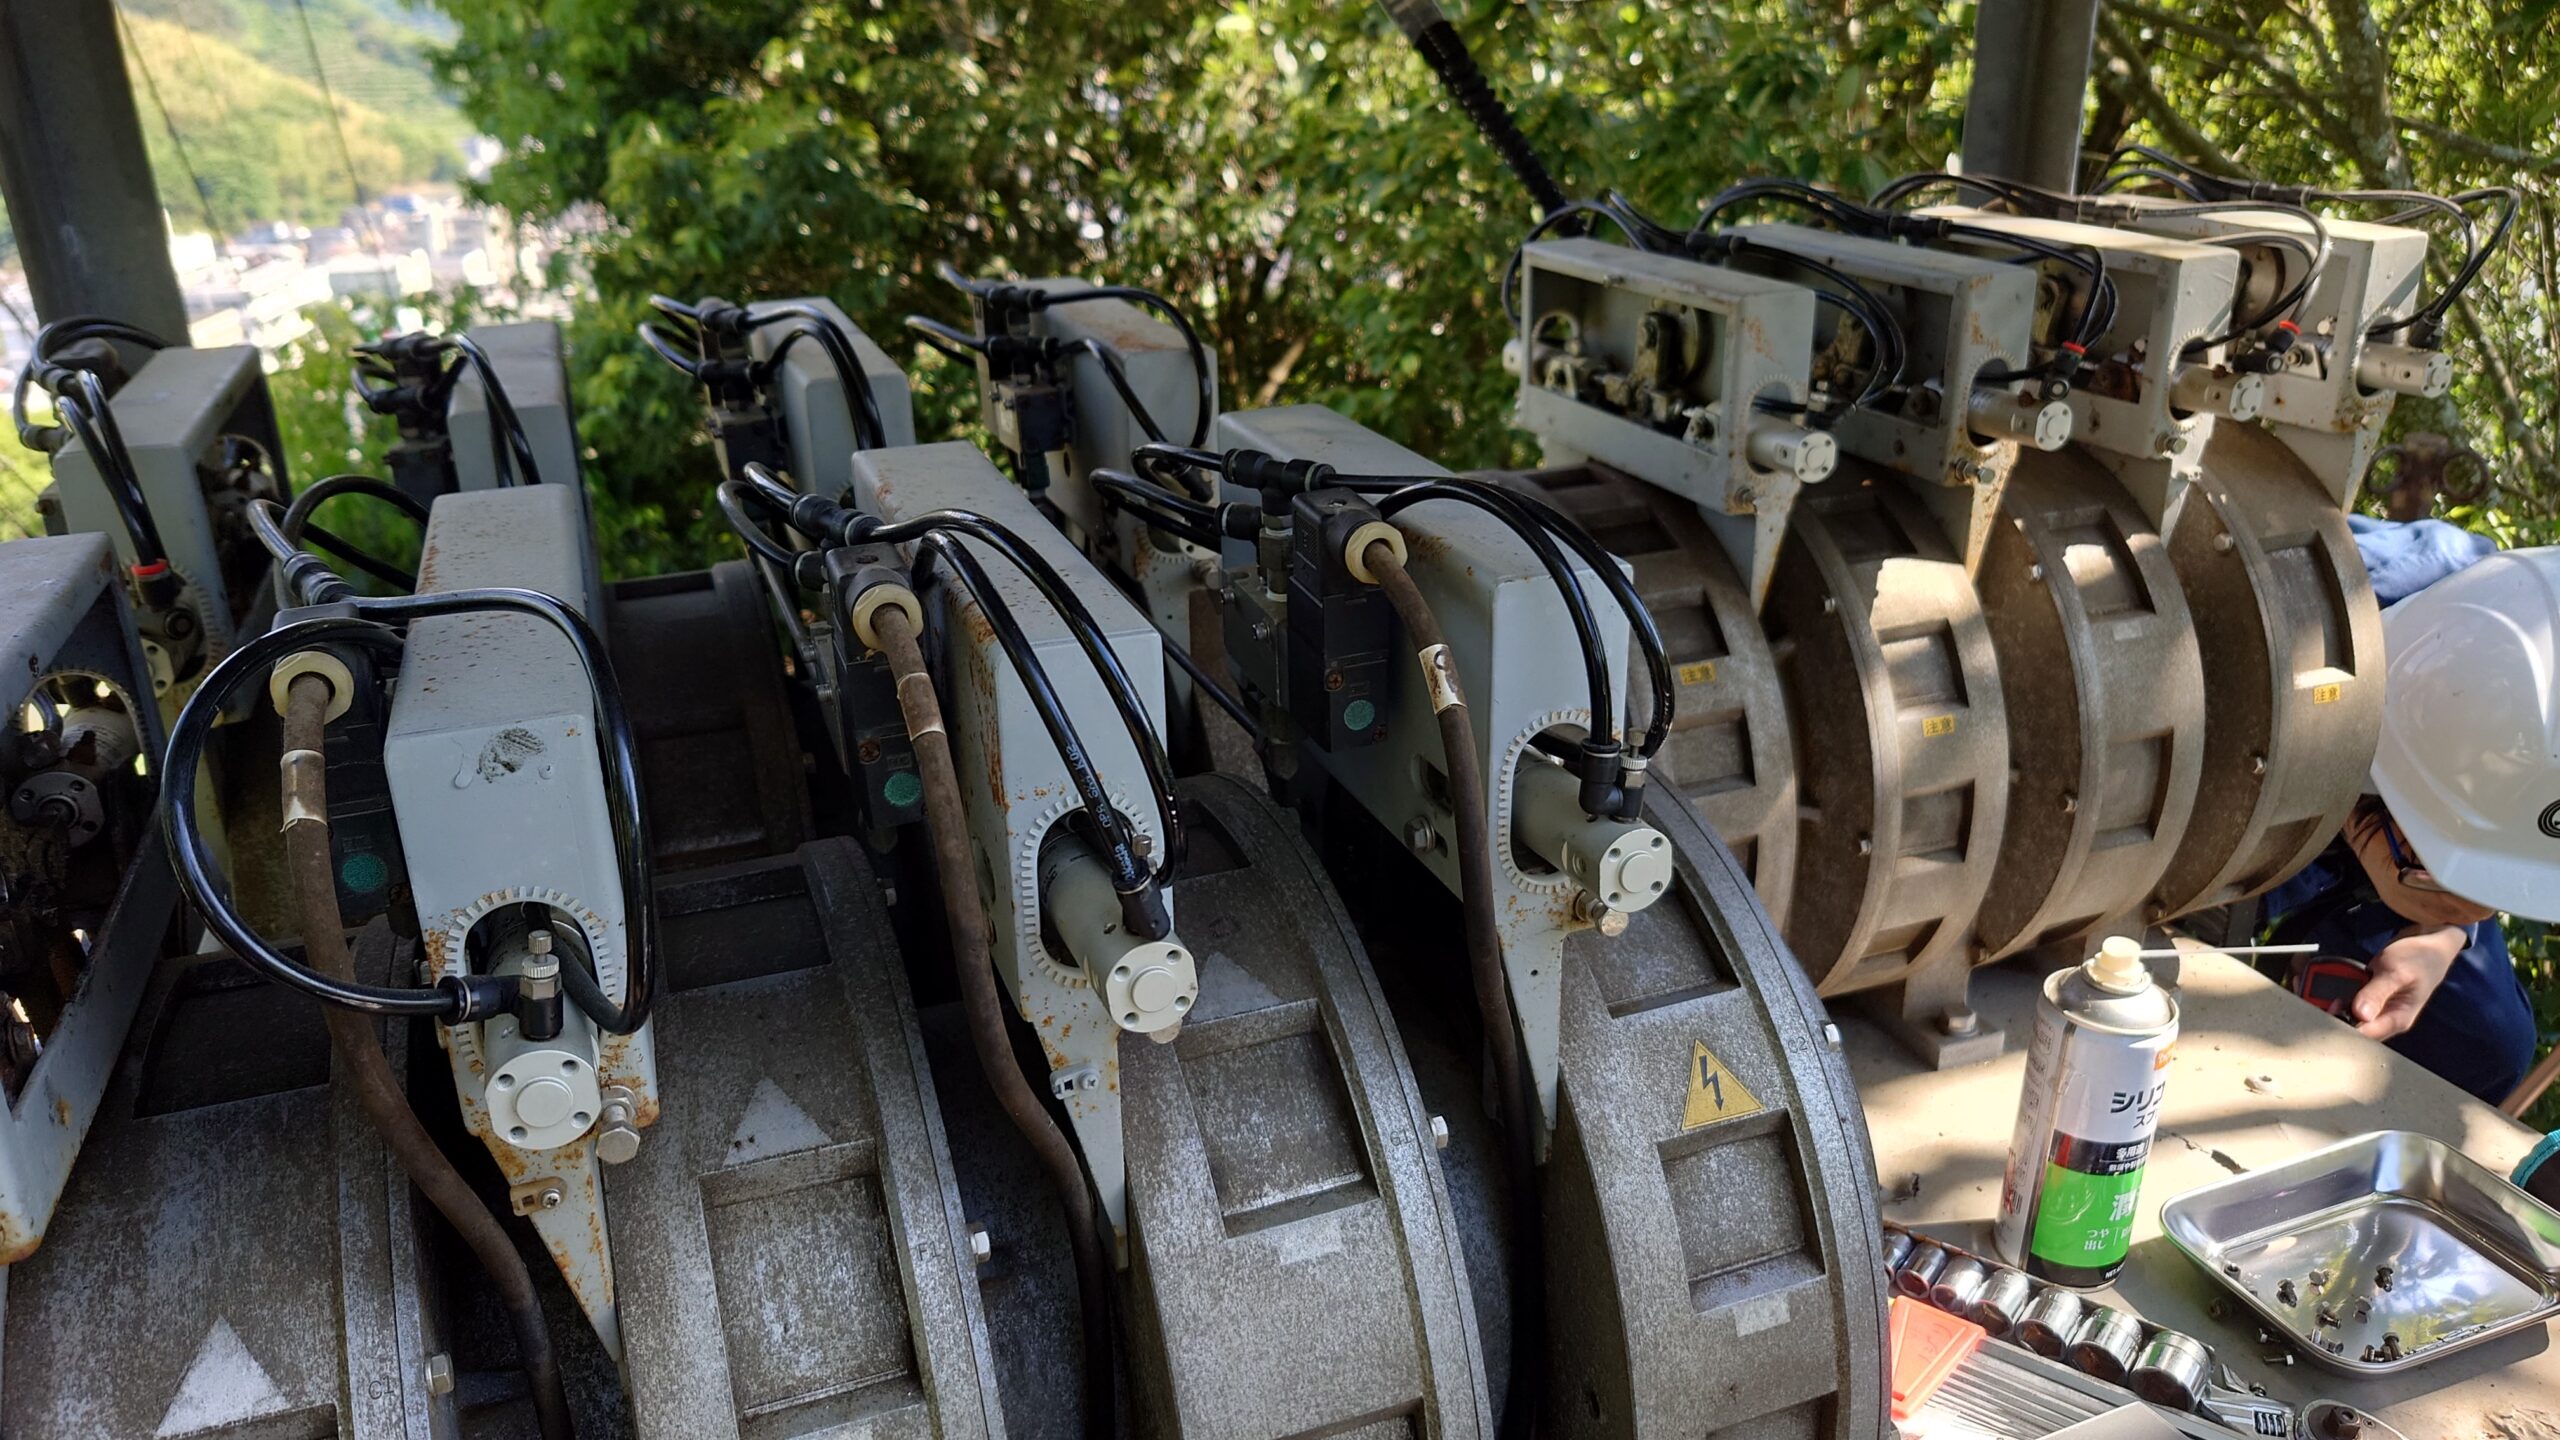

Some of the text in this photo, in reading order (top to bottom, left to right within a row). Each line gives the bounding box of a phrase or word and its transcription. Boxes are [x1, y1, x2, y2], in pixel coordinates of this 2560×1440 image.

[1924, 717, 1952, 735] 注意
[2087, 1228, 2109, 1238] つや
[2084, 1240, 2106, 1250] 出し
[368, 1374, 394, 1400] C1
